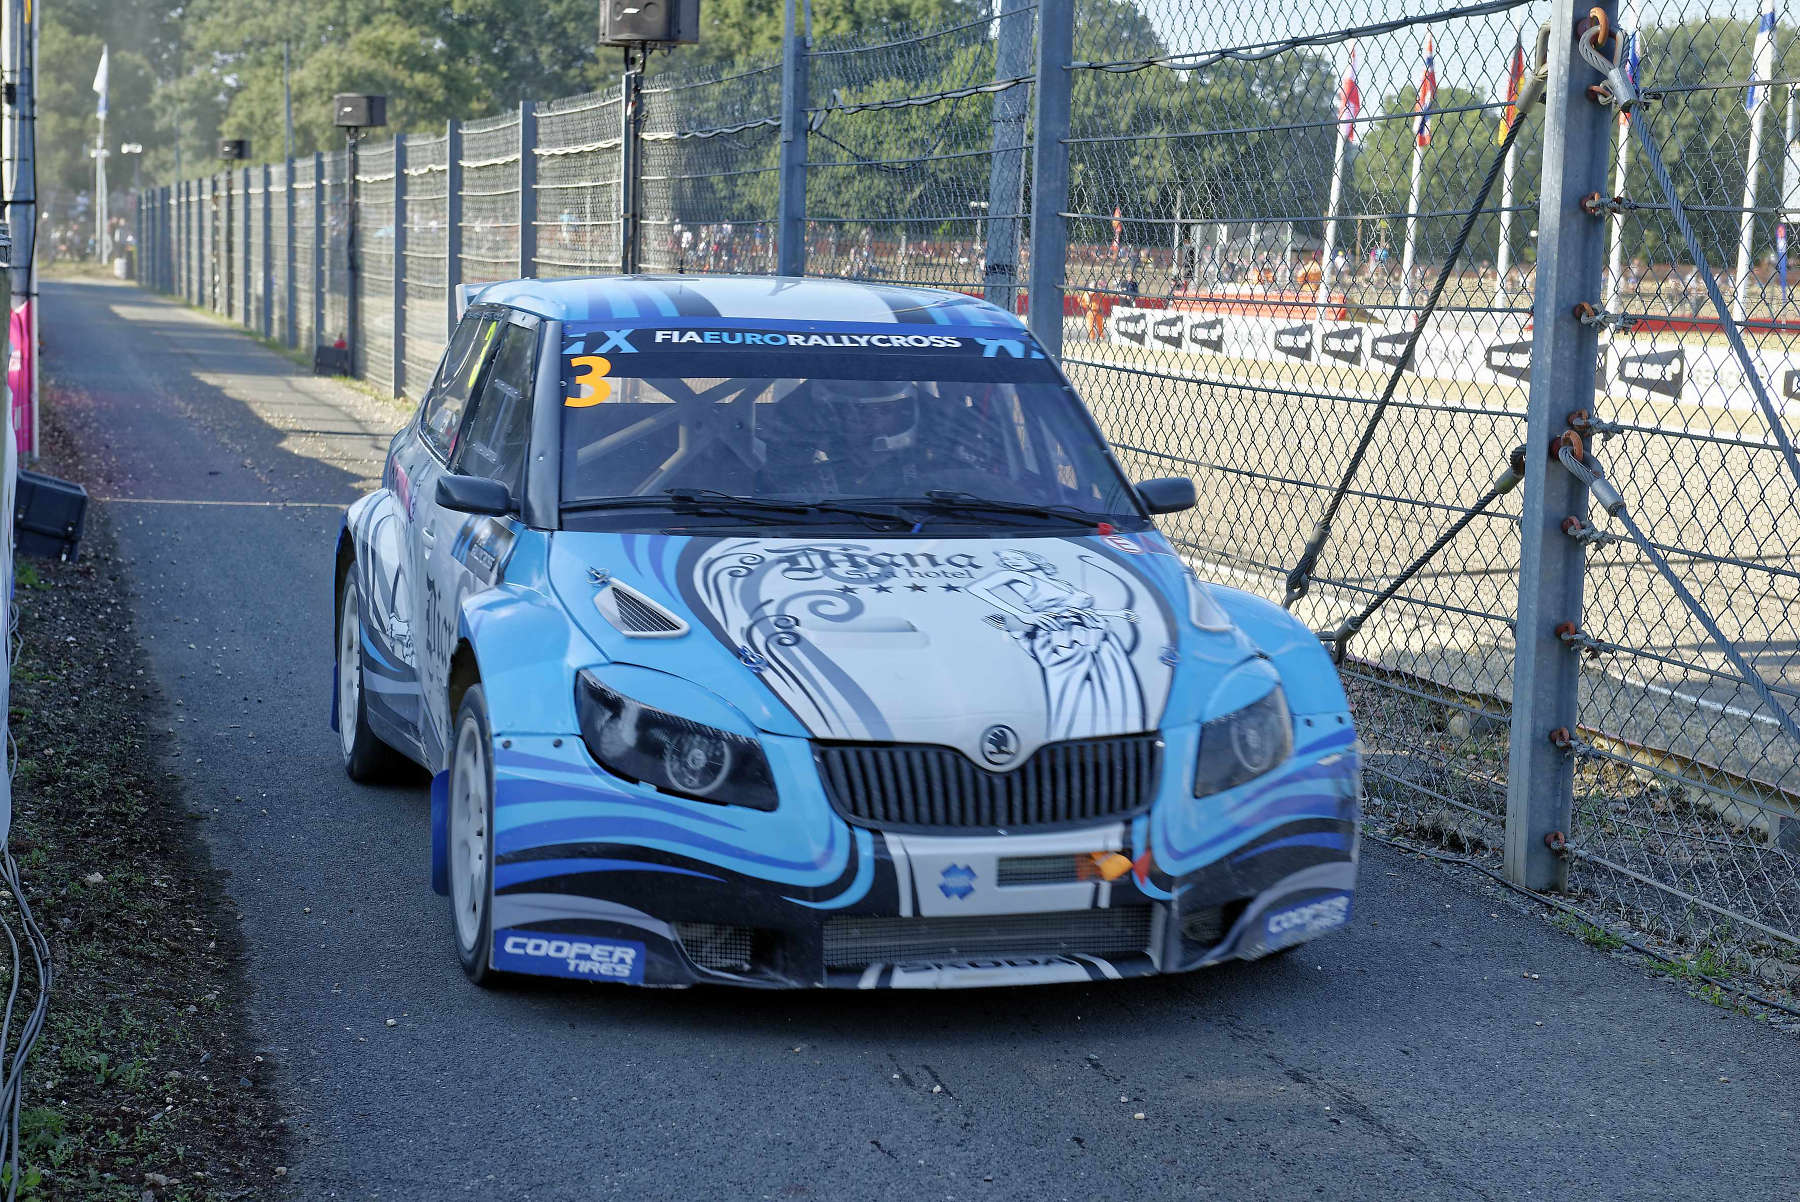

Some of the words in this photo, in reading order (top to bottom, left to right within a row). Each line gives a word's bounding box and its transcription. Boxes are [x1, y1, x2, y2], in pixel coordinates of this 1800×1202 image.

[655, 330, 962, 348] FIAEURORALLYCROSS
[564, 356, 611, 407] 3
[764, 547, 984, 581] Diana
[846, 569, 898, 583] Spa
[904, 568, 975, 579] hotel
[504, 936, 637, 965] COOPER
[566, 958, 633, 978] TIRES
